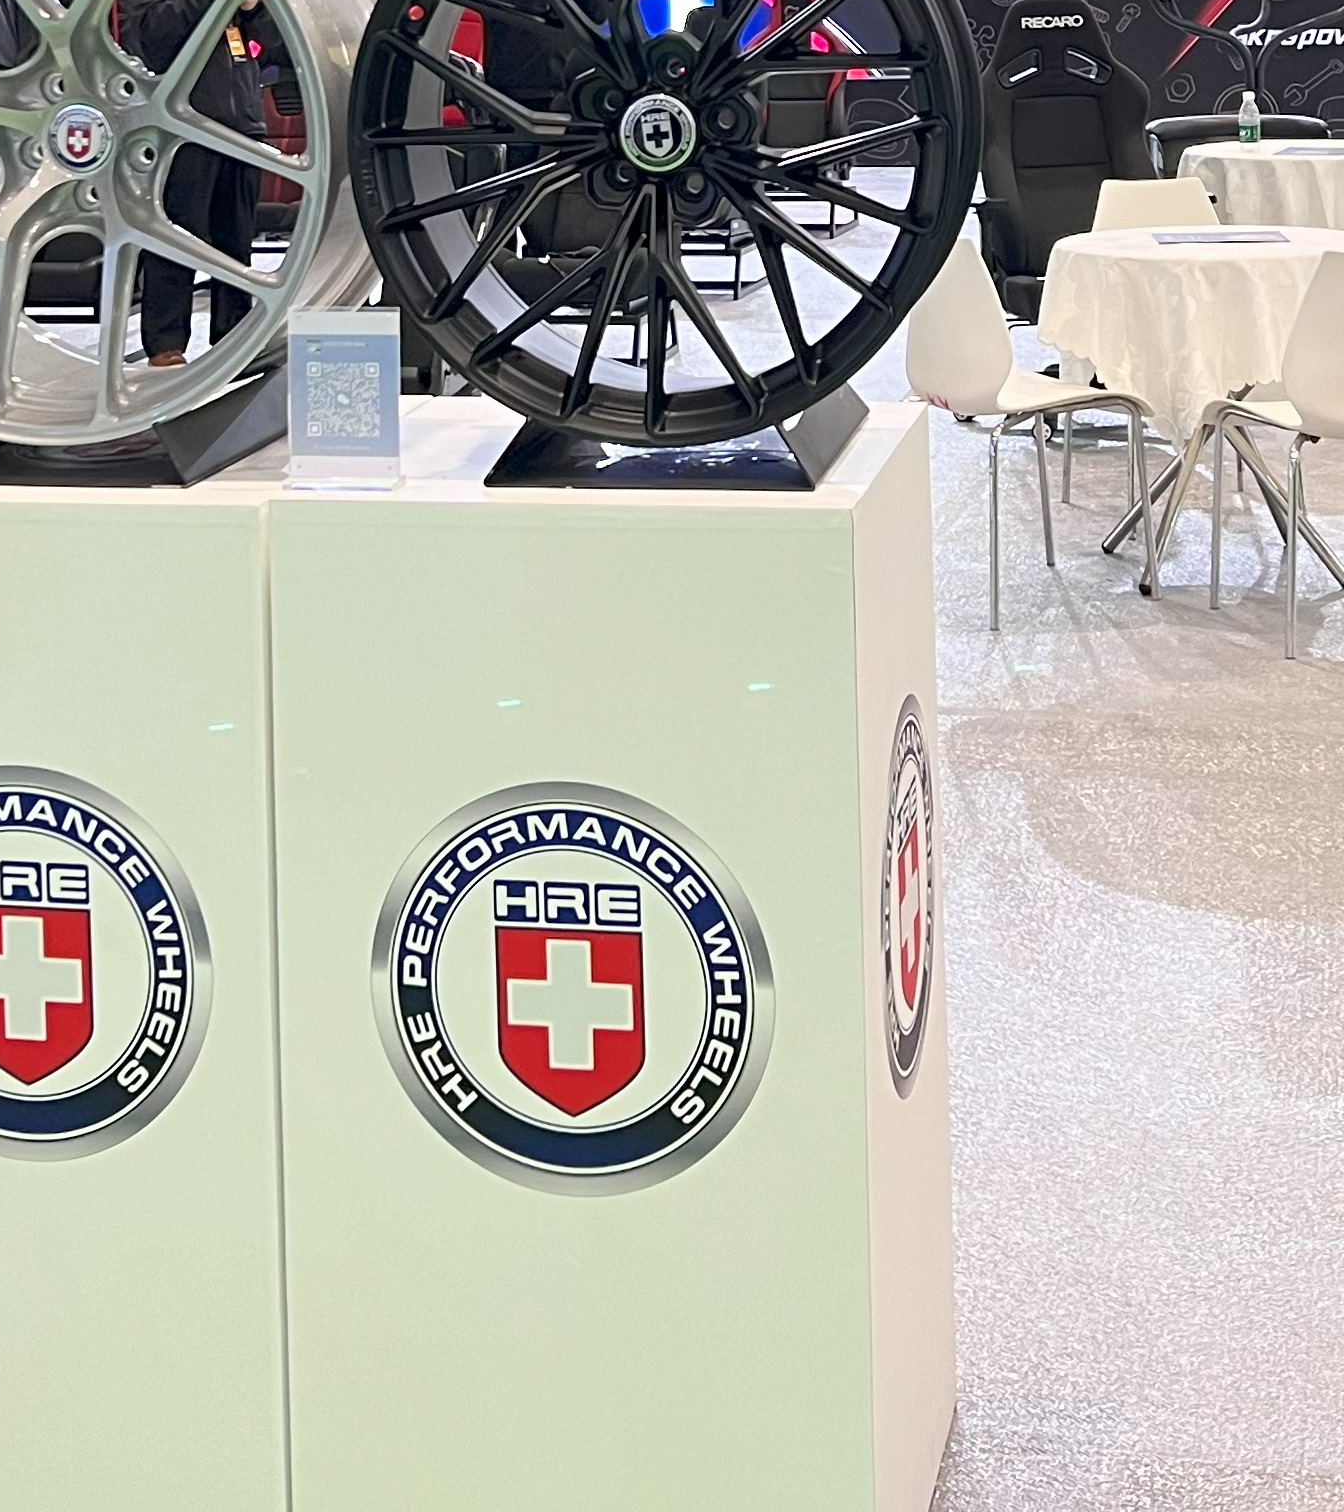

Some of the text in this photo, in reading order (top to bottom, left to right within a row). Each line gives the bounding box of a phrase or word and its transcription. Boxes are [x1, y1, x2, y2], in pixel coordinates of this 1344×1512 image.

[1021, 15, 1084, 30] RECARO
[402, 812, 708, 988] PERFORMANCE
[495, 884, 640, 923] HRE
[116, 899, 184, 1095] WHEELS
[407, 1010, 478, 1113] HRE
[669, 920, 744, 1125] WHEELS
